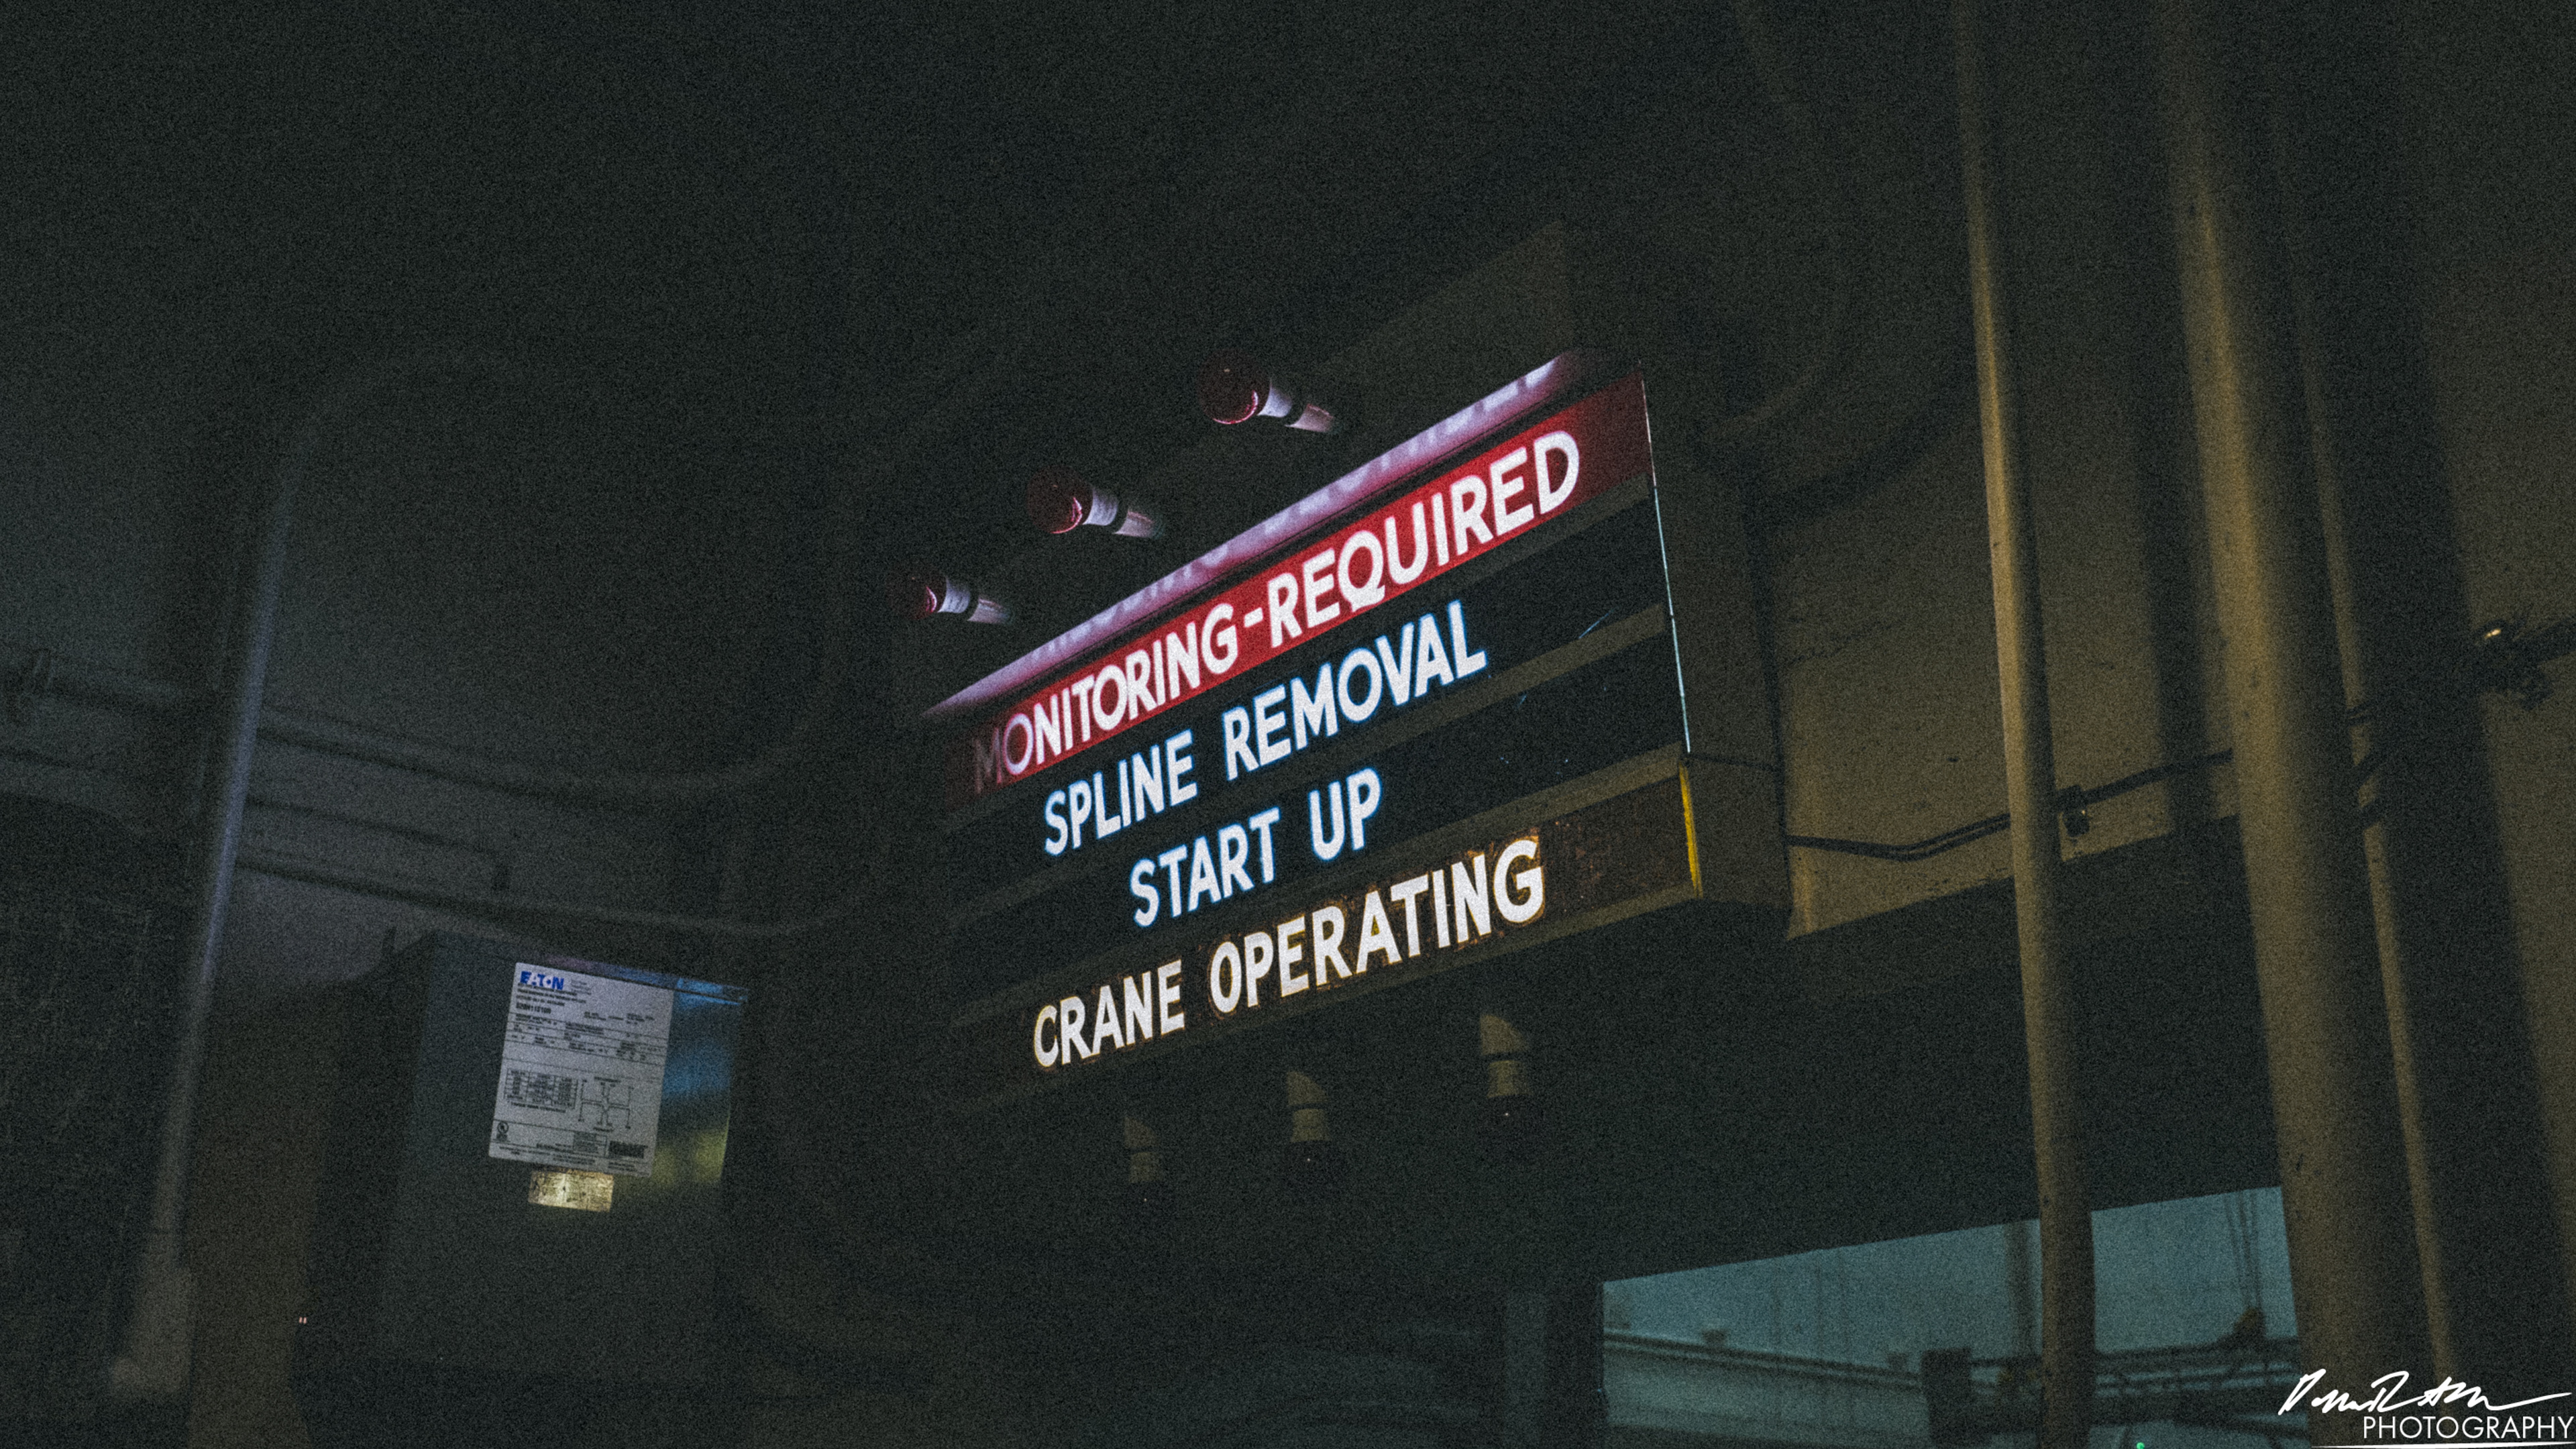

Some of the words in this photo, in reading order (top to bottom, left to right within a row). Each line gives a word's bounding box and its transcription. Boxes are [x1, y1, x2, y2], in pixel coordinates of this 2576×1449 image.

[975, 430, 1581, 794] MONITORING-REQUIRED
[1044, 729, 1199, 857] SPLINE
[1222, 600, 1488, 781] REMOVAL
[1034, 959, 1186, 1068] CRANE
[1210, 835, 1545, 1014] OPERATING
[1130, 807, 1281, 928] START
[1309, 768, 1382, 861] UP
[519, 971, 565, 991] EATON
